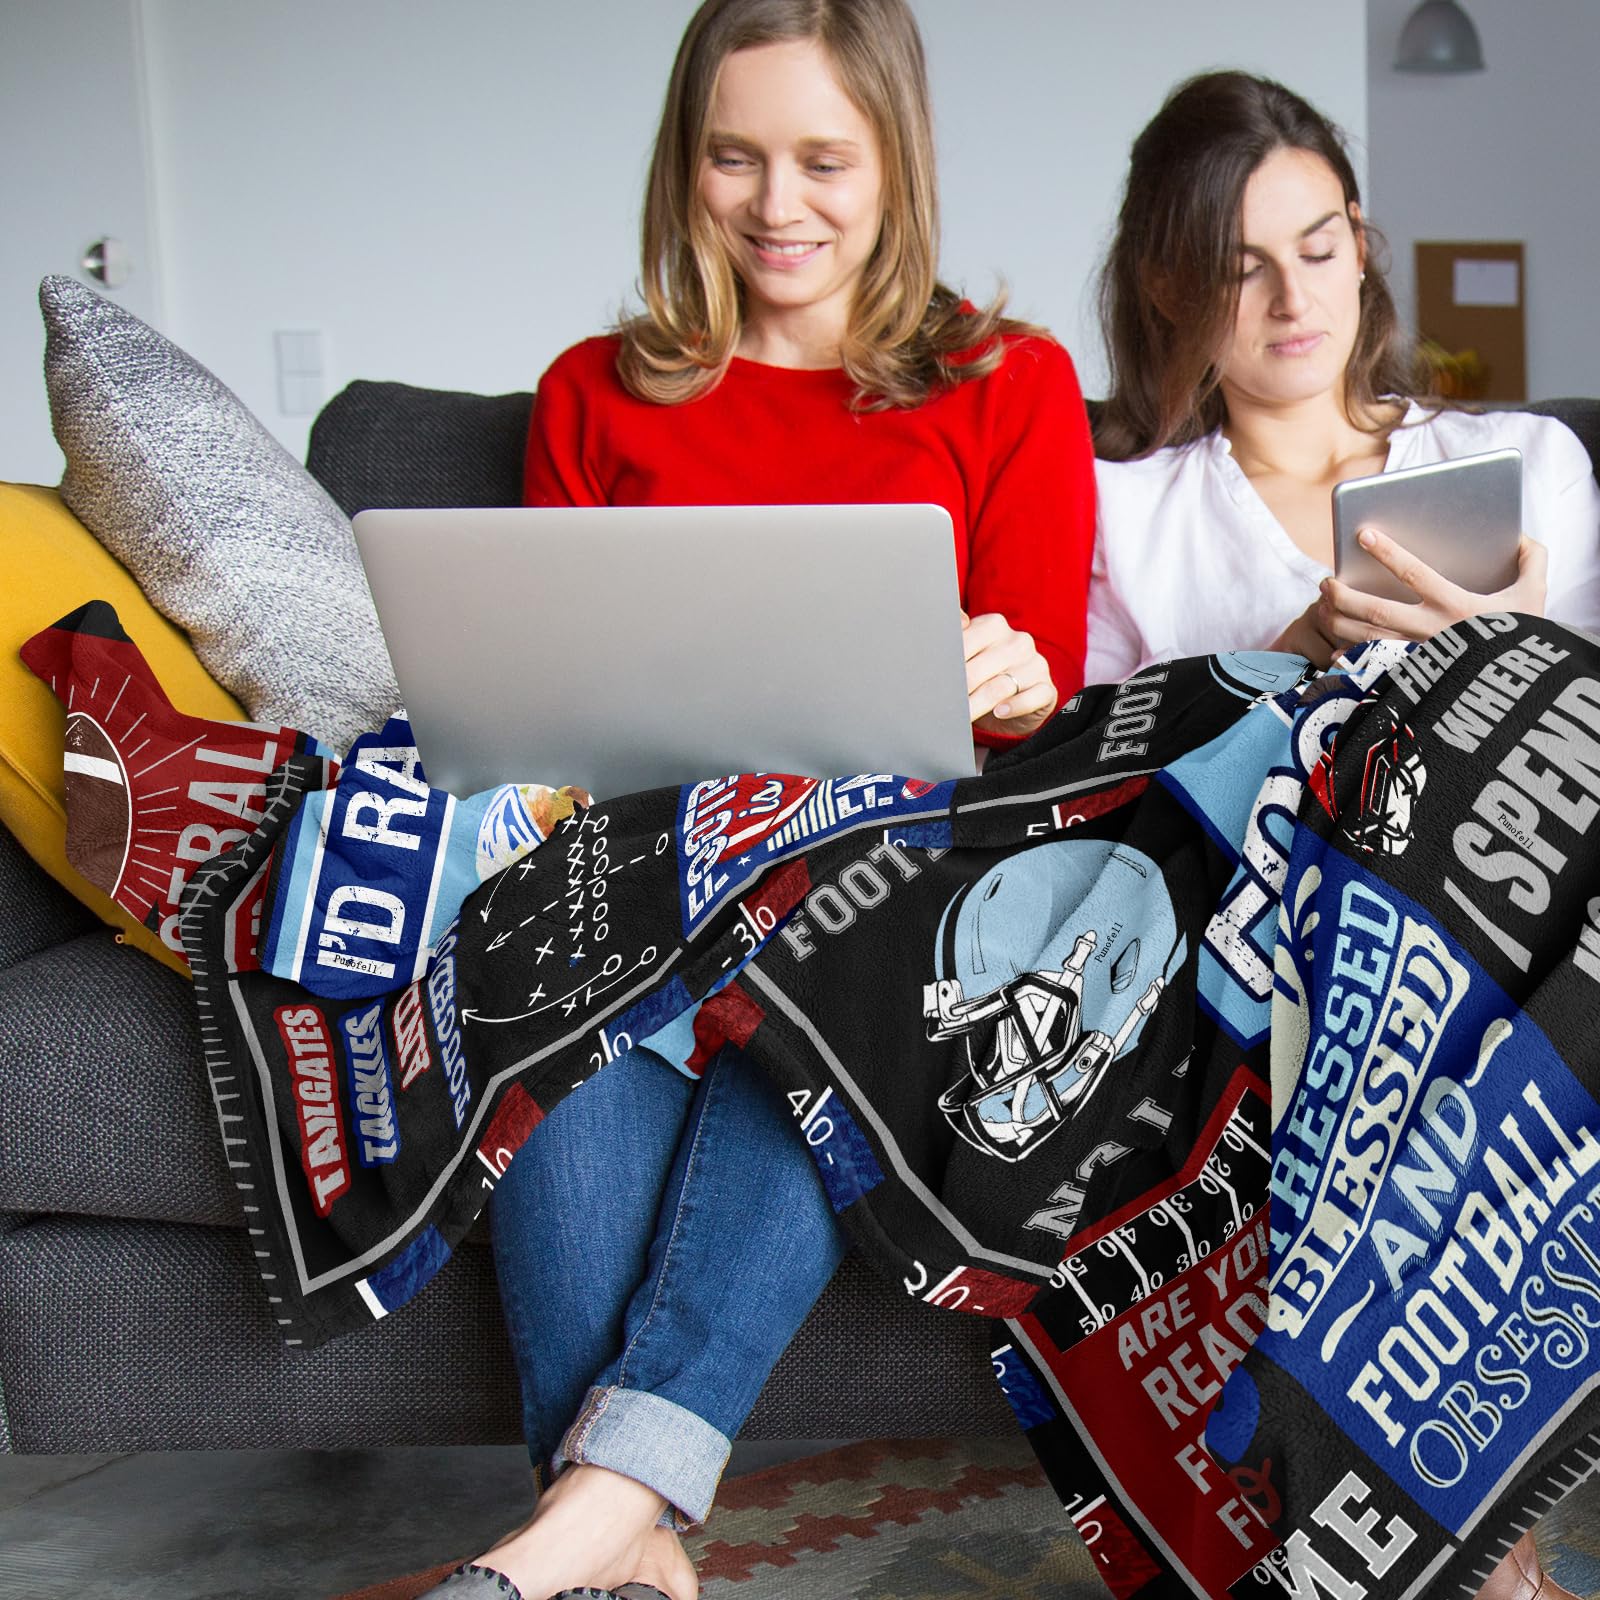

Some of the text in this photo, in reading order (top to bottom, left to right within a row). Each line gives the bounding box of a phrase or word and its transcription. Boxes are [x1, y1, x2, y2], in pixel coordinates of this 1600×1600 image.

[1097, 656, 1172, 763] FOOT
[1432, 635, 1572, 753] WHERE
[342, 747, 430, 851] RA
[1498, 813, 1535, 850] Punofell
[780, 842, 950, 961] FOOT
[1094, 922, 1124, 964] Punofell
[345, 1007, 397, 1163] TACKLES
[395, 983, 429, 1087] AND
[1271, 942, 1454, 1321] BLESSED
[1370, 1076, 1479, 1296] AND
[1347, 1080, 1600, 1448] FOOTBALL
[1117, 1283, 1196, 1371] ARE
[1141, 1276, 1269, 1431] READ
